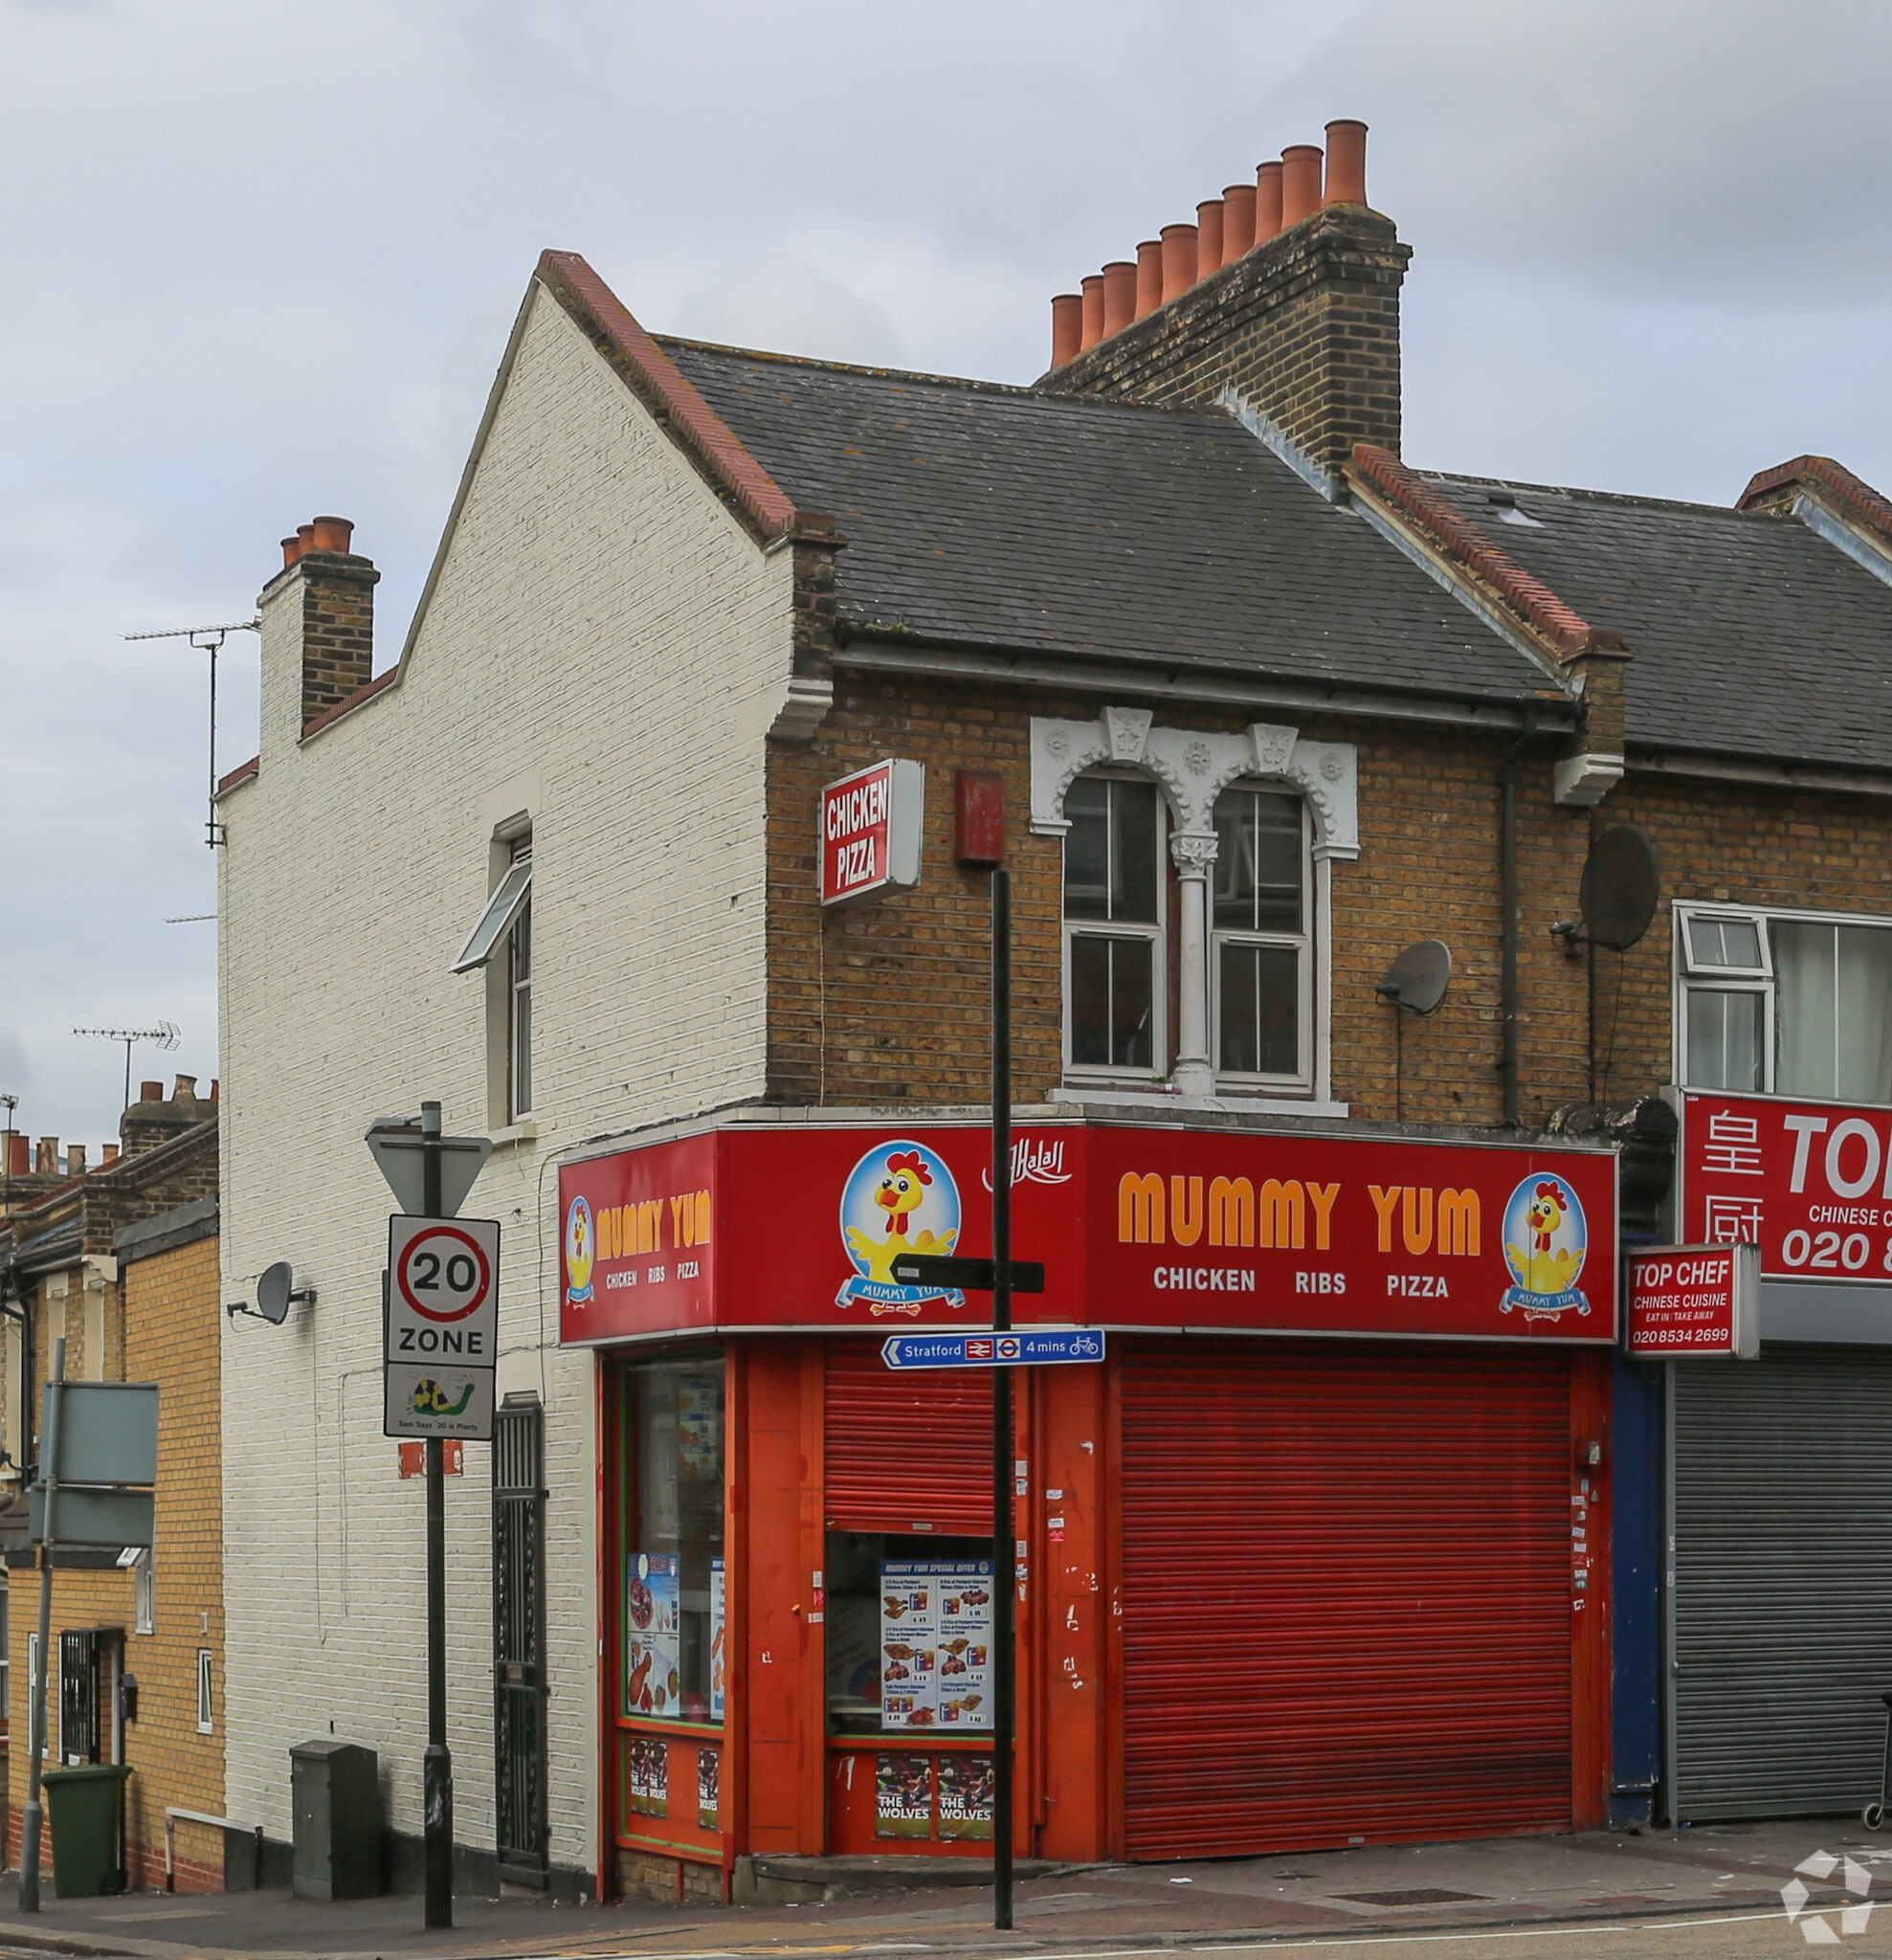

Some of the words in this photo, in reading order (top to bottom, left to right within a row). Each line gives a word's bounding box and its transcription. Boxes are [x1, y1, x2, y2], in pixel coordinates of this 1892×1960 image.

[827, 778, 888, 841] CHICKEN
[836, 836, 876, 889] PIZZA
[1783, 1114, 1892, 1199] TO
[1118, 1171, 1341, 1250] MUMMY
[1368, 1185, 1481, 1257] YUM
[1809, 1205, 1879, 1226] CHINESE
[596, 1199, 664, 1261] MUMMY
[670, 1190, 710, 1249] YUM
[1782, 1229, 1870, 1270] 020
[413, 1252, 477, 1293] 20
[606, 1270, 637, 1290] CHICKEN
[648, 1265, 665, 1284] RIBS
[677, 1260, 700, 1281] PIZZA
[1153, 1266, 1256, 1292] CHICKEN
[1295, 1271, 1347, 1295] RIBS
[1387, 1275, 1449, 1298] PIZZA
[1635, 1263, 1673, 1287] TOP
[1676, 1259, 1729, 1285] CHEF
[862, 1284, 907, 1300] MUMMY
[1518, 1293, 1550, 1307] MUMMY
[1556, 1293, 1575, 1305] YUM
[1634, 1295, 1681, 1309] CHINESE
[1682, 1293, 1727, 1307] CUISINE
[1645, 1313, 1660, 1322] EAT
[1660, 1312, 1669, 1321] IN
[1674, 1311, 1692, 1321] TAKE
[1693, 1310, 1714, 1320] AWAY
[398, 1328, 484, 1355] ZONE
[1633, 1331, 1658, 1344] 020
[1658, 1329, 1692, 1344] 8534
[1695, 1328, 1728, 1342] 2699
[904, 1344, 961, 1357] Stratford
[1026, 1341, 1035, 1352] 4
[1037, 1341, 1066, 1352] mins
[415, 1421, 433, 1430] Says
[879, 1796, 902, 1808] THE
[940, 1796, 965, 1809] THE
[879, 1807, 929, 1819] WOLVES
[940, 1808, 991, 1820] WOLVES
